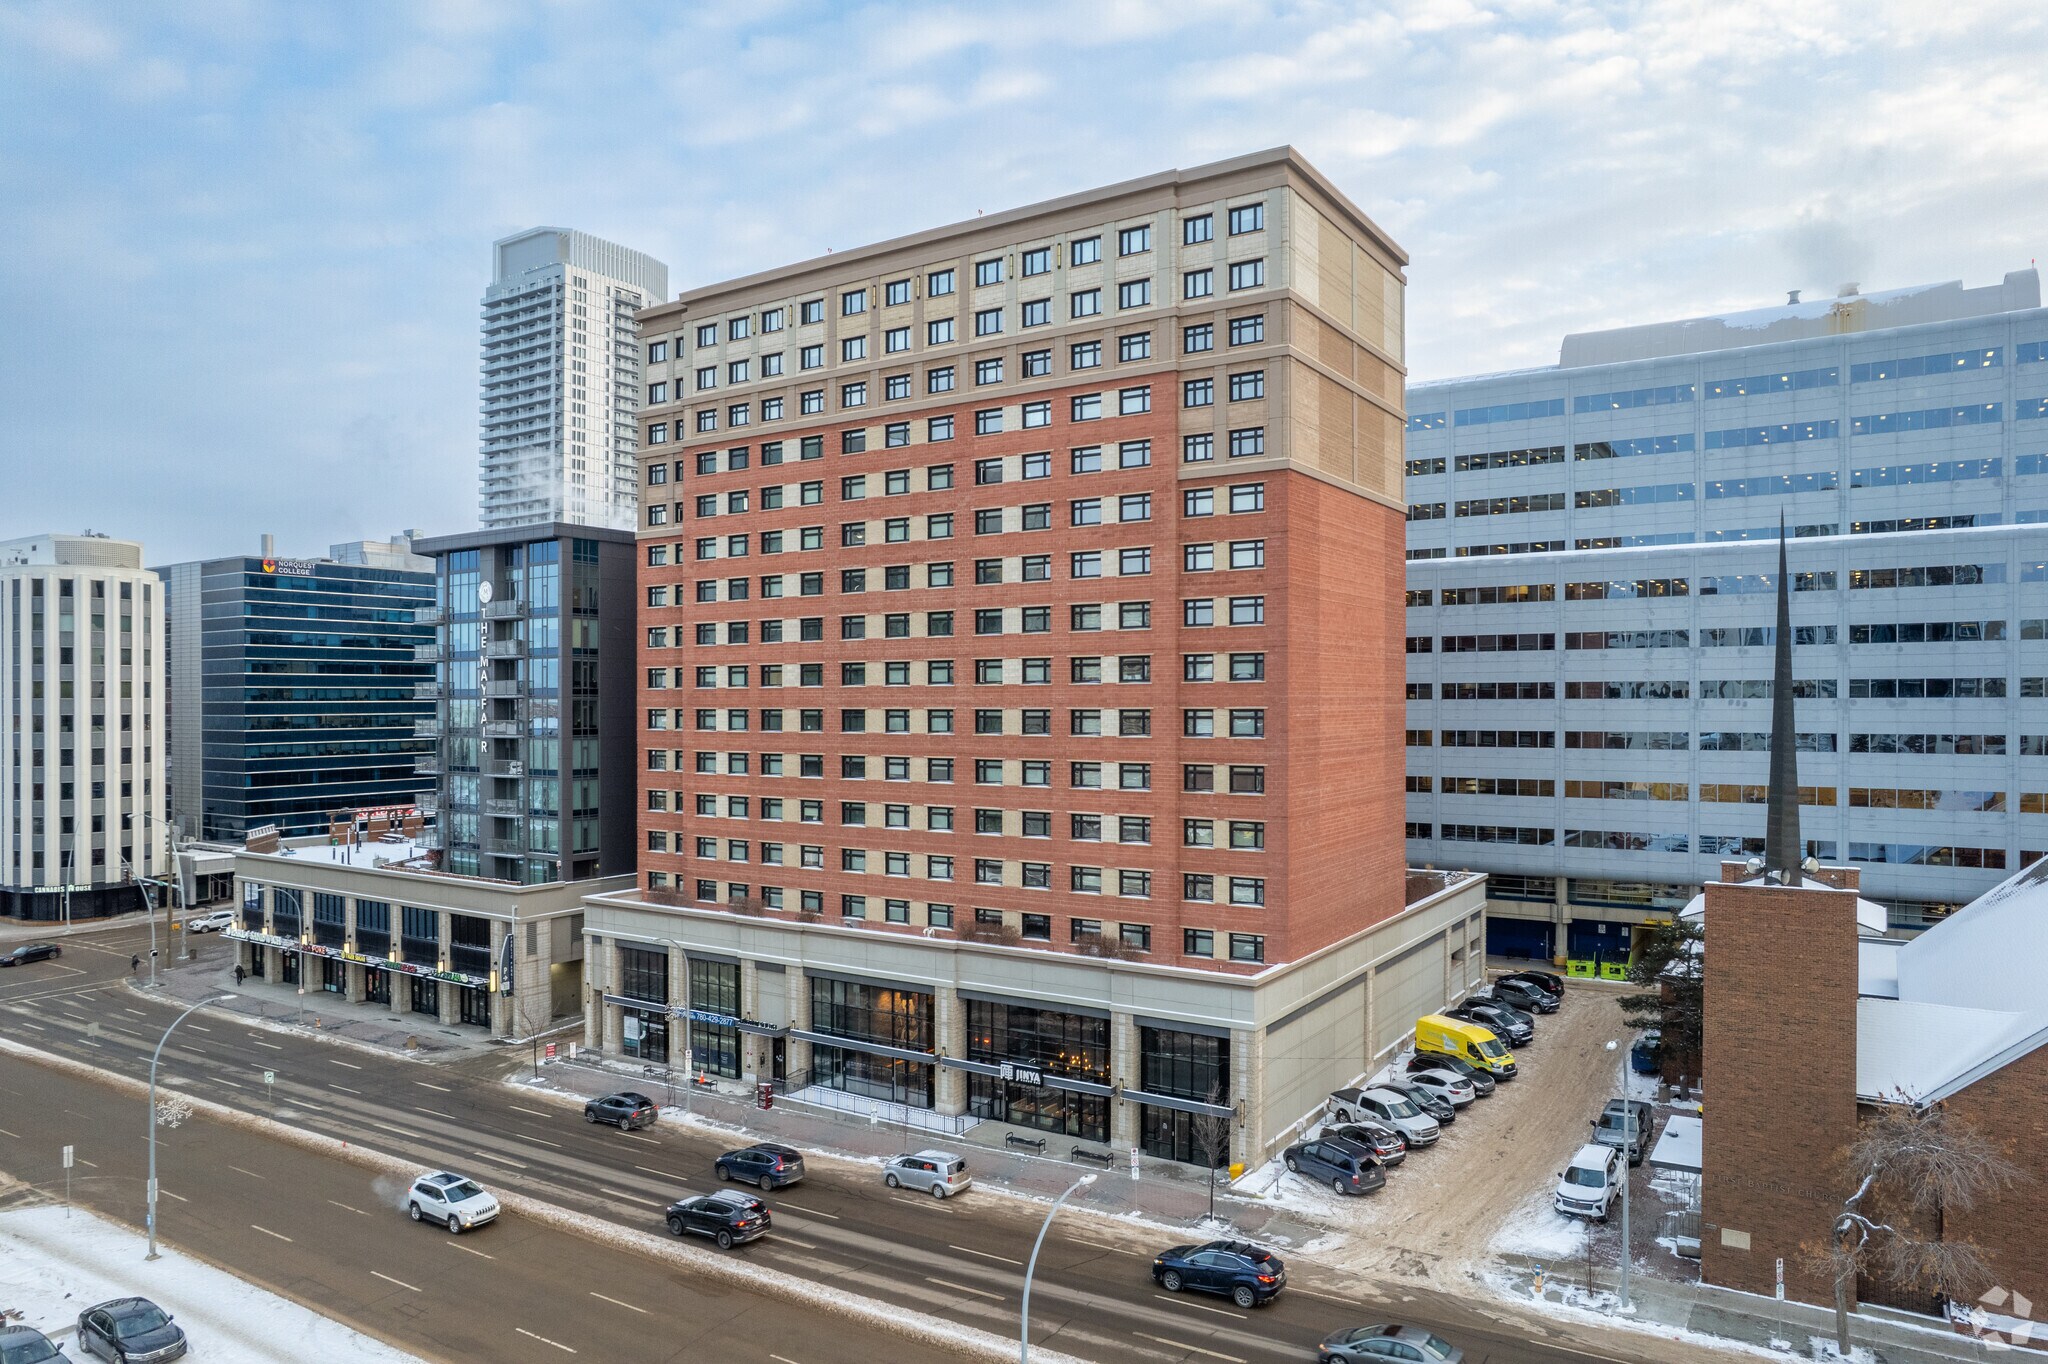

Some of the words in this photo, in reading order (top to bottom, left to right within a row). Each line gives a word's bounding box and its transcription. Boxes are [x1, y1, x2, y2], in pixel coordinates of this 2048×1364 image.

[278, 561, 316, 569] NORQUEST
[480, 607, 488, 648] THE
[480, 655, 489, 753] MAYFAIR
[312, 945, 327, 954] POKE
[696, 1013, 733, 1025] 780-429-2877
[1015, 1069, 1041, 1083] JINYA
[1712, 1173, 1741, 1184] FIRST
[1748, 1180, 1791, 1194] BAPTIST
[1798, 1189, 1845, 1202] CHURCH
